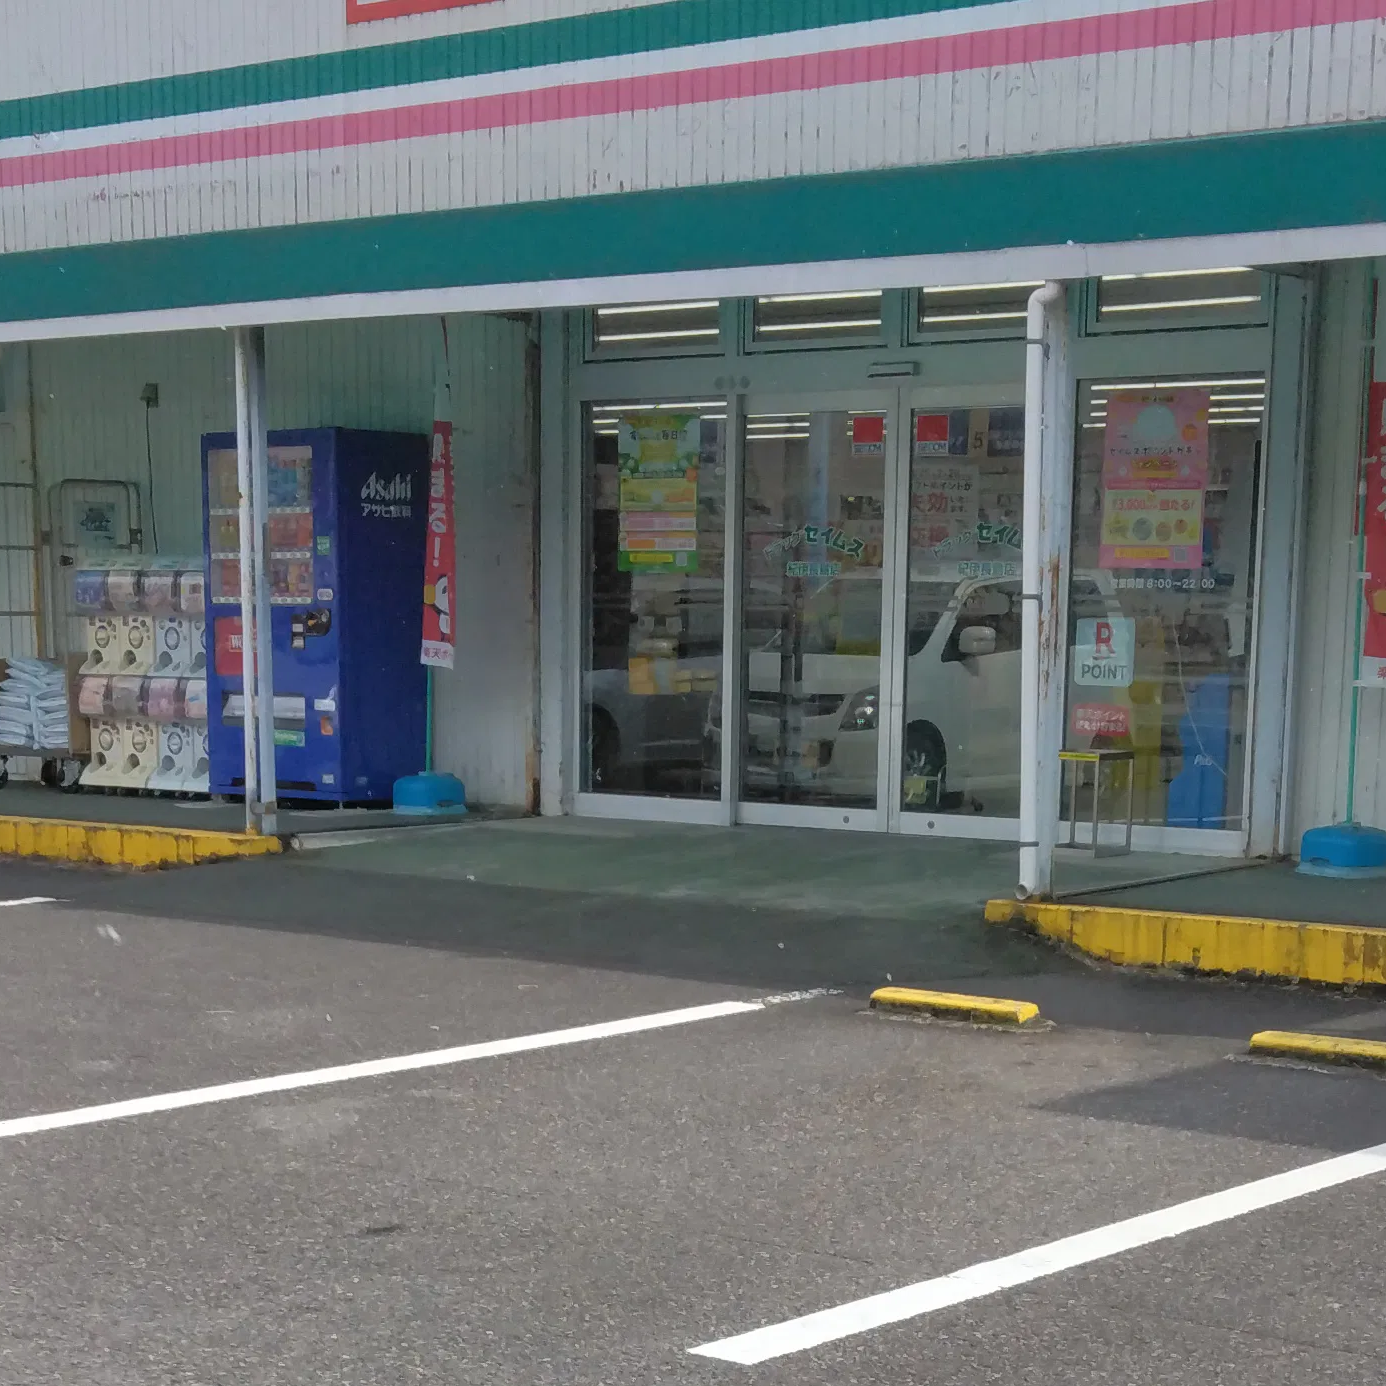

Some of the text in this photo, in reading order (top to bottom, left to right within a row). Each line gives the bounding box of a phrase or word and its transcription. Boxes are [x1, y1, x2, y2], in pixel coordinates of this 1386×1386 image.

[360, 471, 412, 502] Asahi
[360, 502, 412, 519] アサヒ飲料
[803, 523, 865, 561] セイムス
[1081, 663, 1129, 681] POINT
